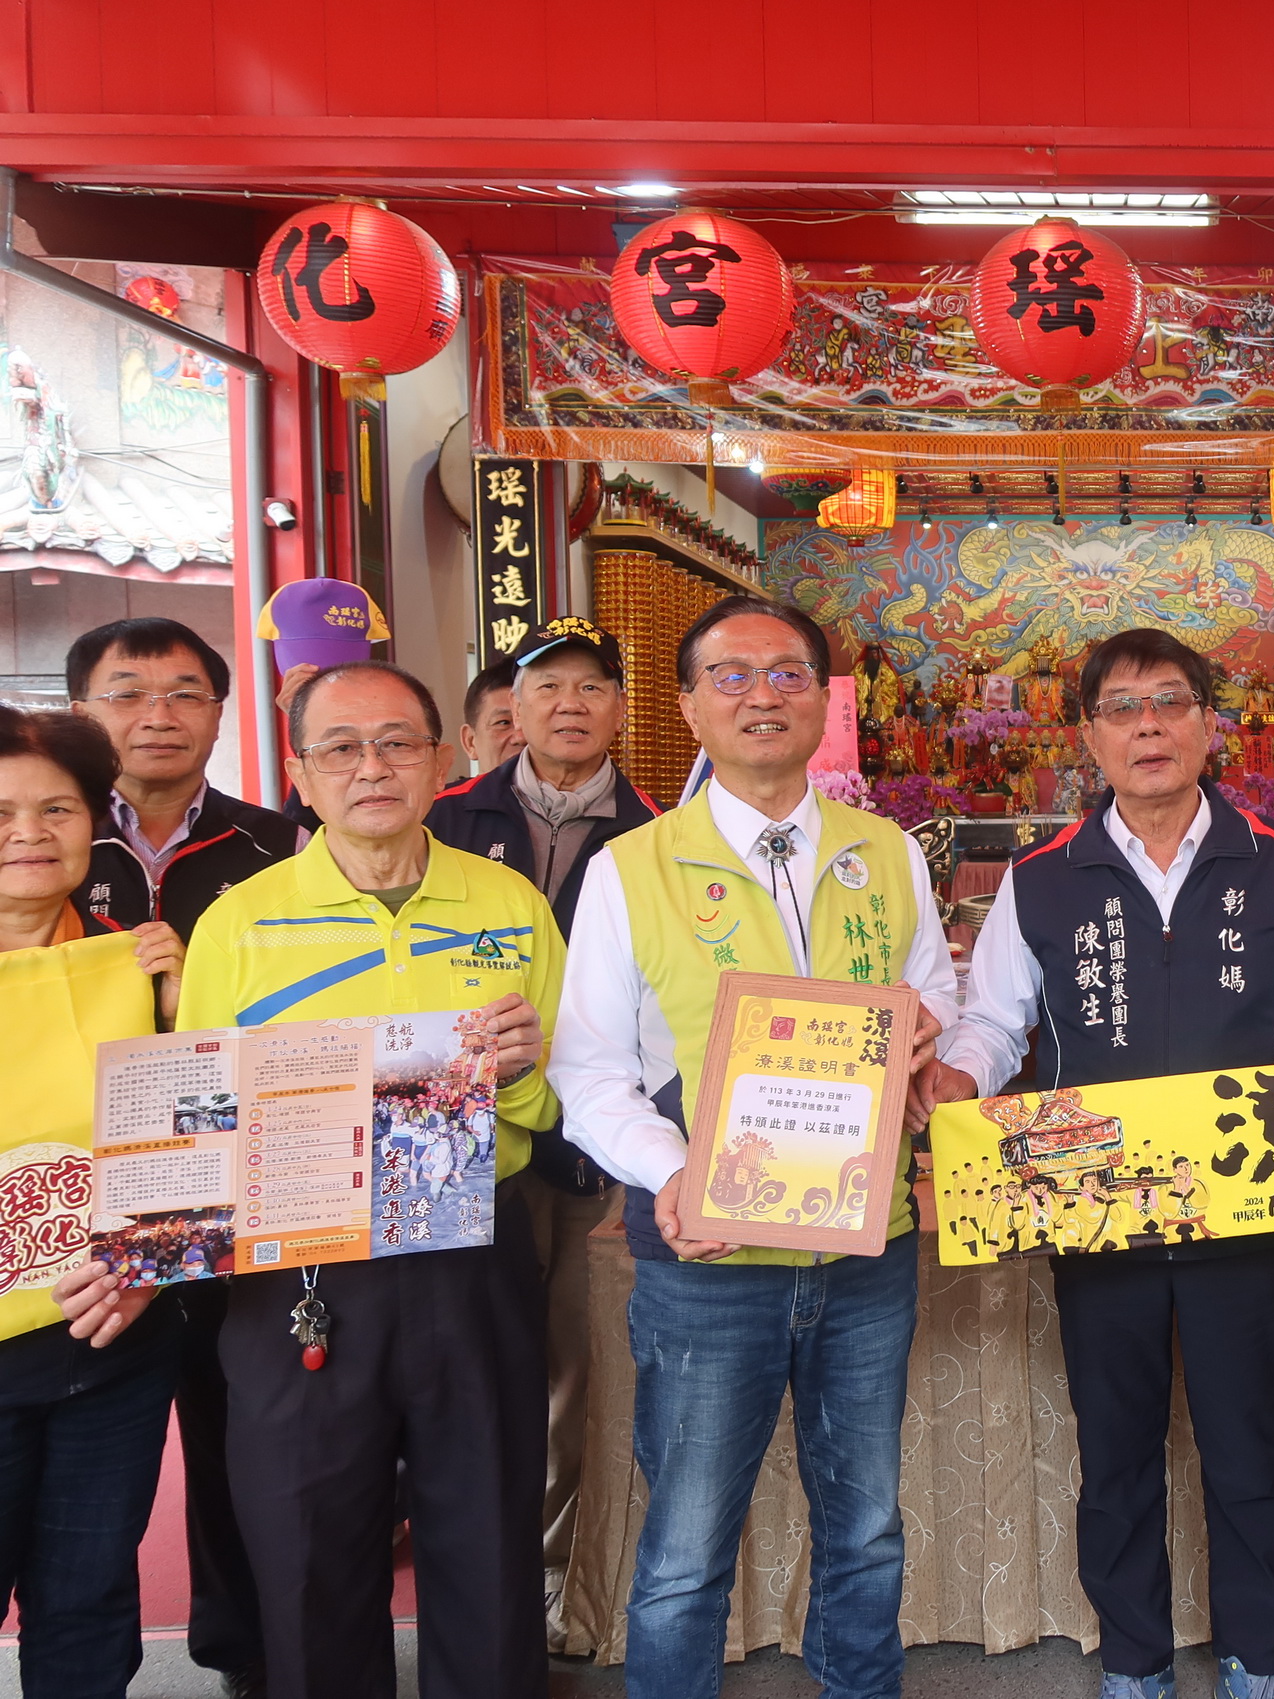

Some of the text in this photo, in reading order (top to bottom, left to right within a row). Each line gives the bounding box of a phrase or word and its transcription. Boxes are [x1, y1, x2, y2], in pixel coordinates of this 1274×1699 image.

[272, 222, 376, 322] 化
[634, 230, 742, 328] 宮
[1008, 240, 1104, 337] 瑤
[1218, 887, 1246, 993] 彰化媽
[713, 943, 741, 970] 微
[1074, 921, 1106, 1026] 陳敏生
[1104, 896, 1129, 1048] 顧問團榮譽團長
[806, 1017, 848, 1034] 南瑤宮
[814, 1033, 854, 1048] 彰化媽
[755, 1053, 860, 1077] 潦溪證明書
[786, 1088, 794, 1096] 年
[804, 1089, 812, 1098] 月
[740, 1114, 860, 1137] 特頒此證 以茲證明
[381, 1149, 408, 1246] 笨港進香
[1244, 1196, 1264, 1206] 2024
[1233, 1208, 1266, 1223] 甲辰年
[22, 1269, 49, 1284] NAN
